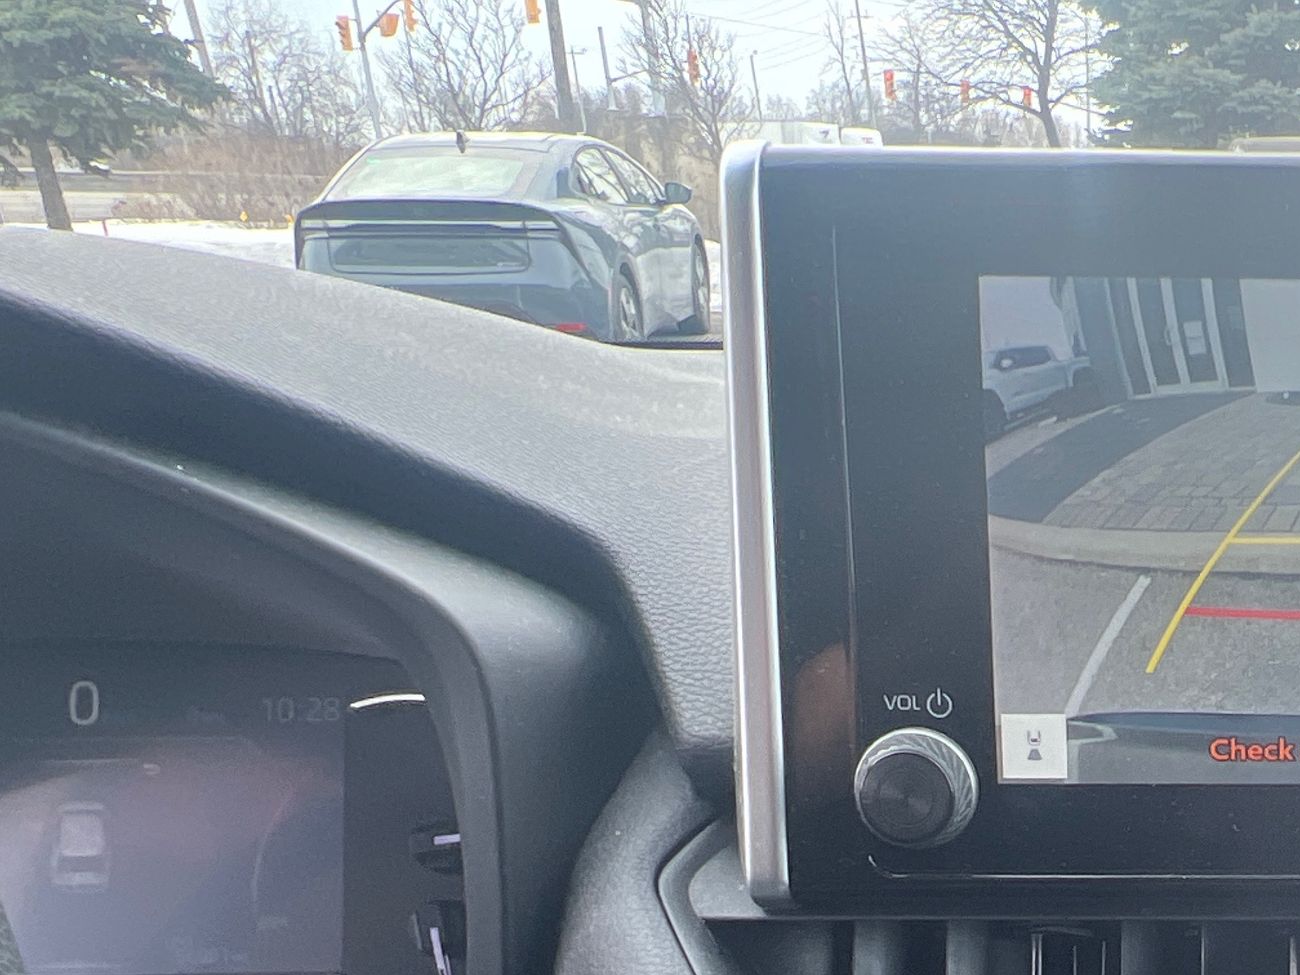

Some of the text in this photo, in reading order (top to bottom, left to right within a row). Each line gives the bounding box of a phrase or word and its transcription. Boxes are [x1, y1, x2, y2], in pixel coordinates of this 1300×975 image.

[69, 681, 100, 725] 0
[883, 694, 921, 711] VOL
[1209, 737, 1295, 762] Check
